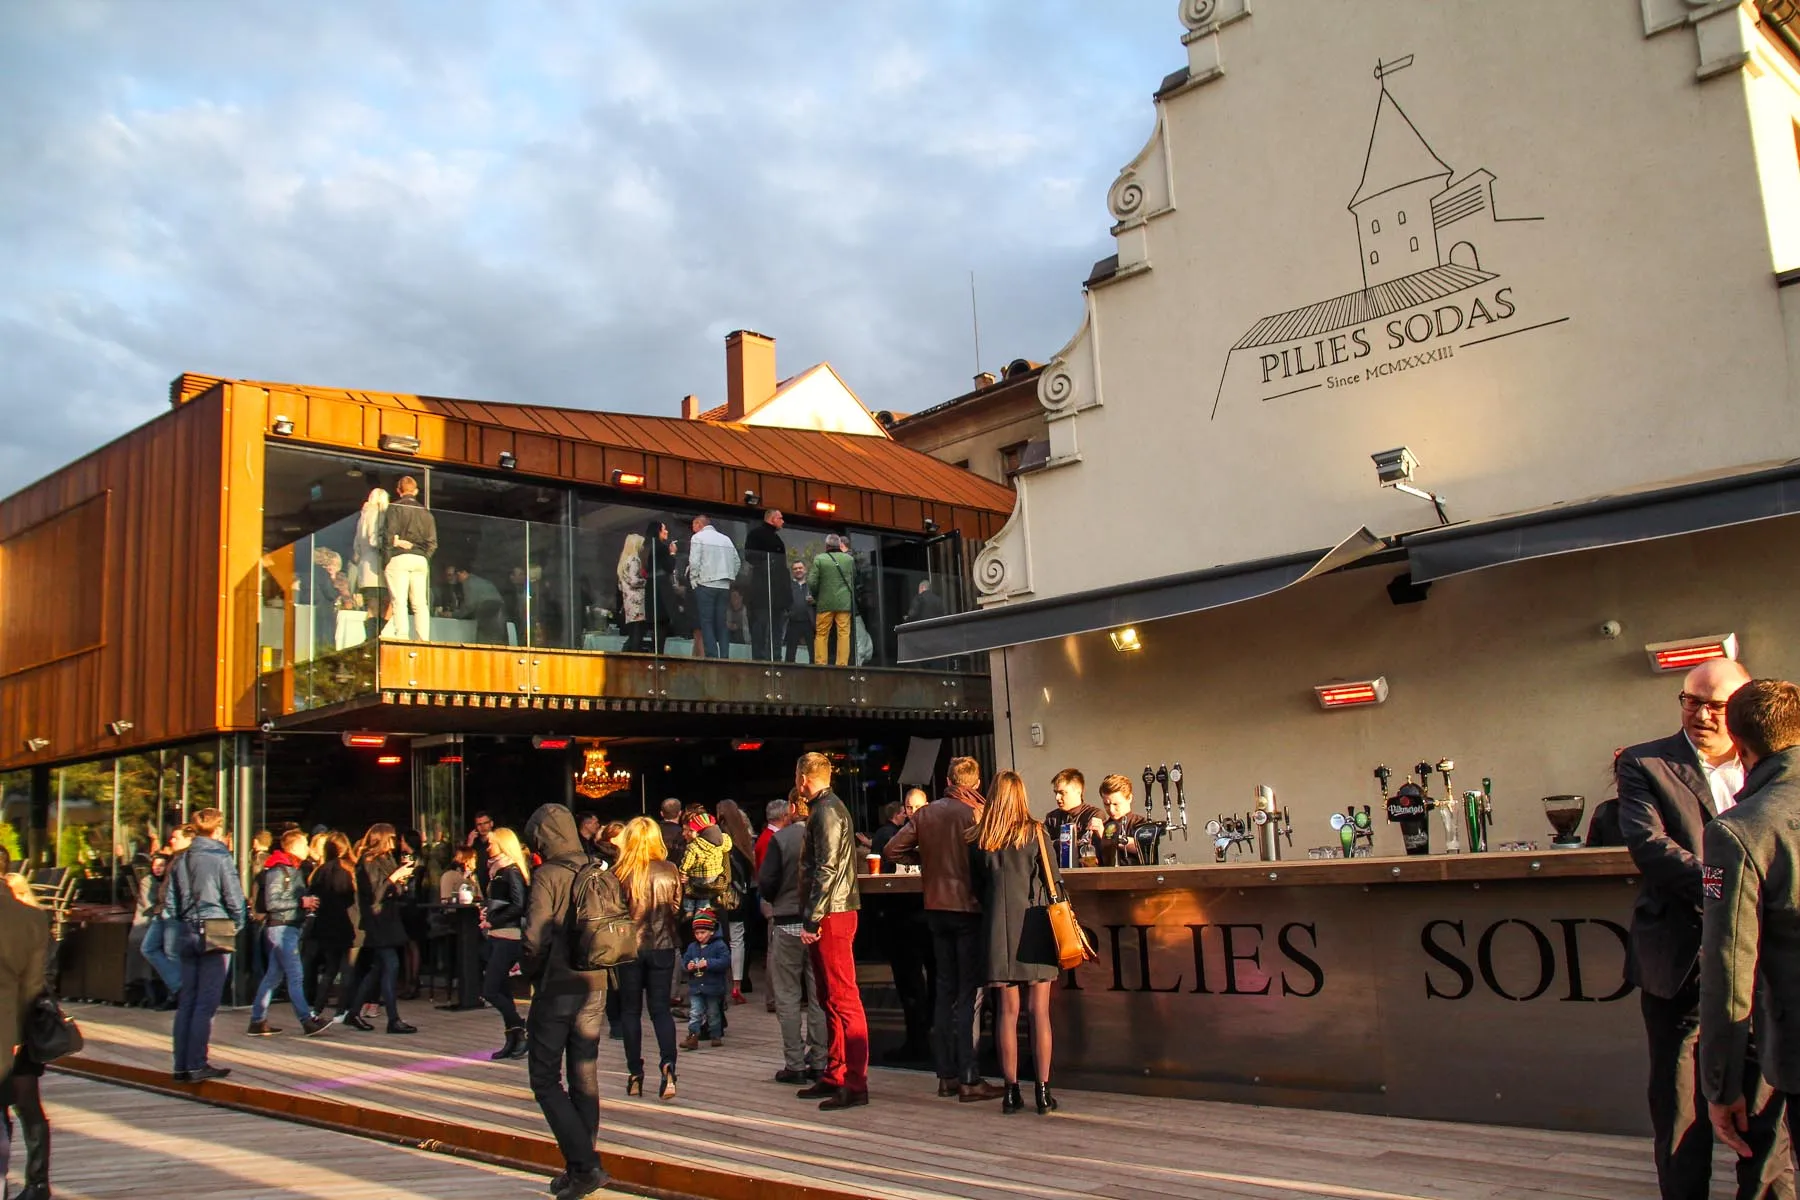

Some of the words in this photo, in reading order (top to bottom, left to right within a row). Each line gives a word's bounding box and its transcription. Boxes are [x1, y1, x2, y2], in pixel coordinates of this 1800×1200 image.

[1259, 327, 1371, 383] PILIES
[1386, 287, 1516, 350] SODAS
[1326, 374, 1360, 389] Since
[1365, 345, 1454, 380] MCMXXXIII
